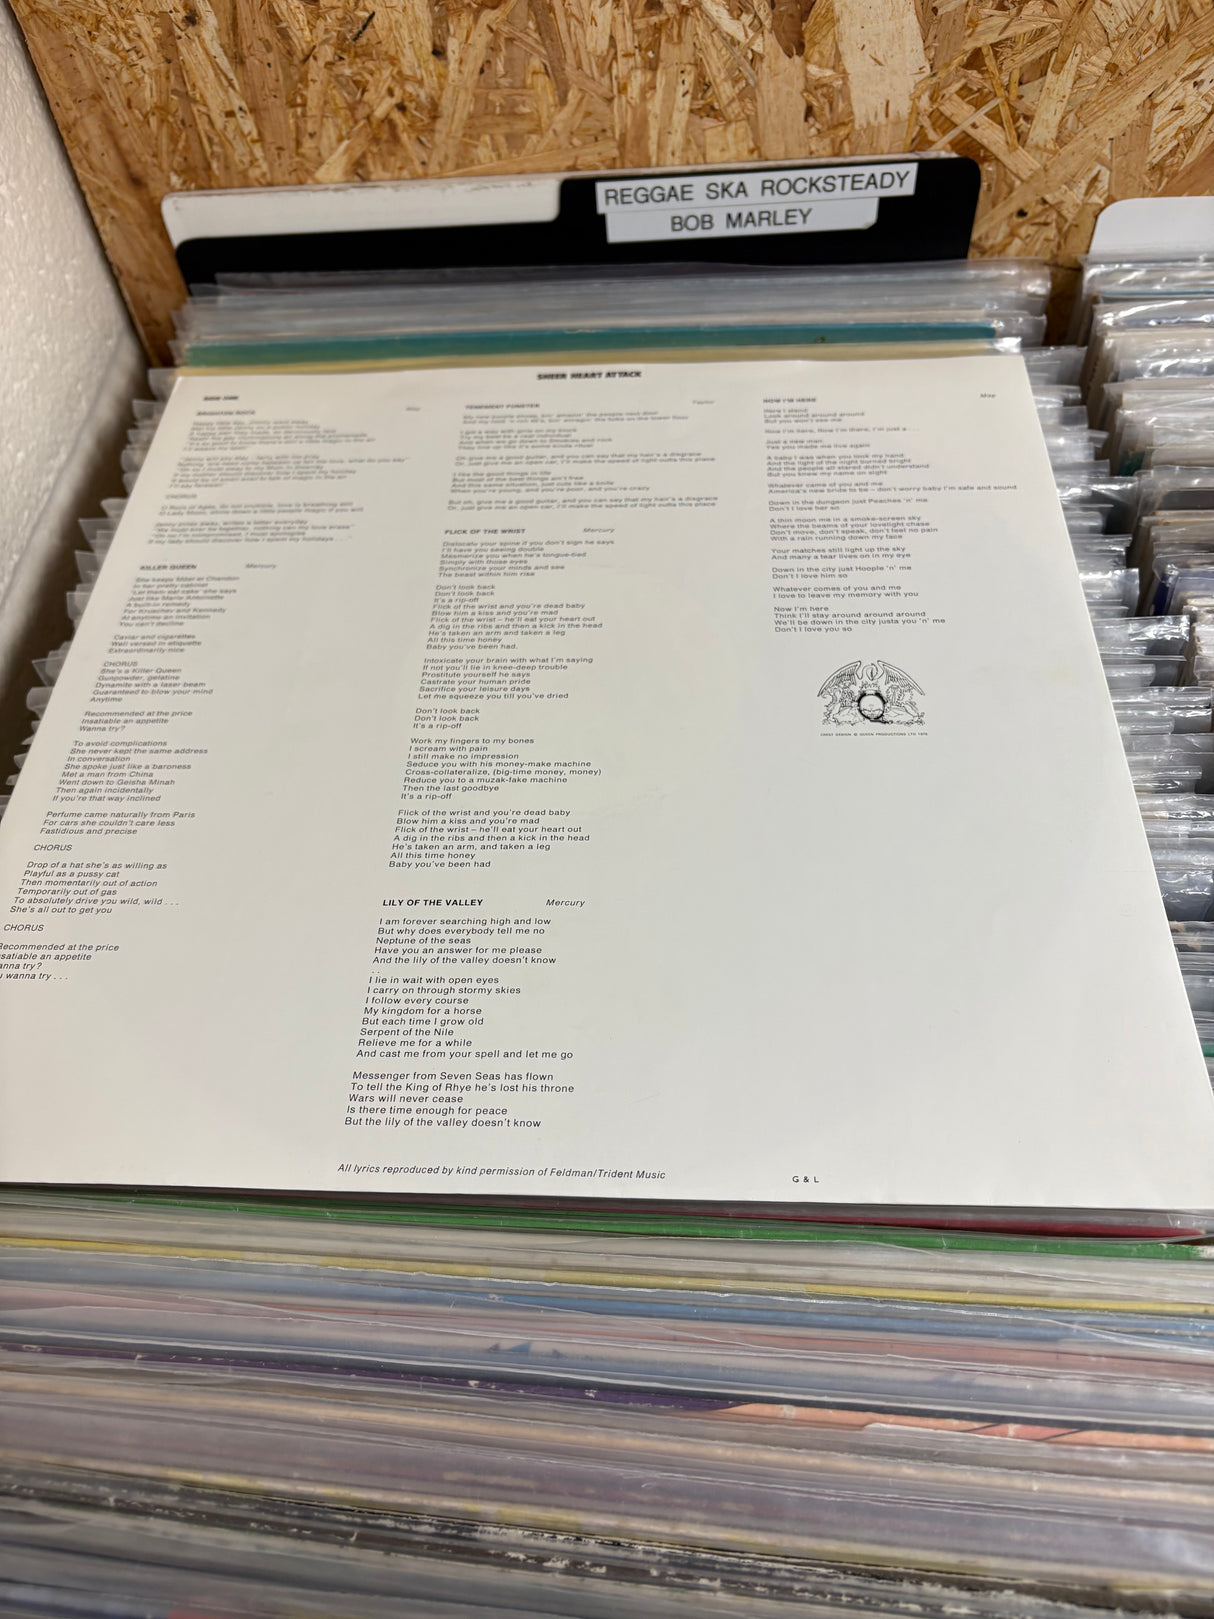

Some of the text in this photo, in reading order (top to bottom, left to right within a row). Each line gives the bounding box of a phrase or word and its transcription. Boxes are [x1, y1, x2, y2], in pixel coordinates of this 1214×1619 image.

[605, 171, 909, 205] REGGAE SKA ROCKSTEADY
[672, 208, 812, 231] BOB MARLEY
[109, 740, 168, 748] complications
[492, 768, 532, 777] (big-time
[569, 768, 602, 777] money)
[489, 817, 518, 826] you're
[447, 851, 476, 860] honey
[23, 870, 55, 879] Playful
[546, 899, 585, 908] Mercury
[78, 906, 94, 915] get
[379, 917, 383, 925] I
[402, 917, 437, 925] forever
[439, 917, 487, 927] searching
[490, 917, 511, 927] high
[513, 917, 532, 925] and
[534, 917, 552, 925] low
[377, 926, 394, 934] But
[396, 926, 416, 936] why
[418, 926, 442, 934] does
[444, 926, 495, 936] everybody
[497, 926, 513, 934] tell
[375, 936, 416, 946] Neptune
[418, 936, 429, 944] of
[430, 936, 446, 944] the
[78, 943, 94, 951] the
[95, 943, 119, 953] price
[367, 985, 371, 994] I
[372, 987, 400, 996] carry
[417, 985, 456, 996] through
[458, 986, 493, 996] stormy
[495, 986, 521, 994] skies
[363, 1006, 379, 1016] My
[381, 1006, 425, 1017] kingdom
[427, 1006, 442, 1014] for
[453, 1006, 482, 1015] horse
[352, 1070, 554, 1082] Messenger from Seven Seas has flown
[351, 1080, 575, 1094] To tell the King of Rhye he's lost his throne
[349, 1092, 375, 1102] Wars
[378, 1092, 397, 1102] will
[337, 1162, 666, 1178] All lyrics reproduced by kind permission of Feldman/Trident Music
